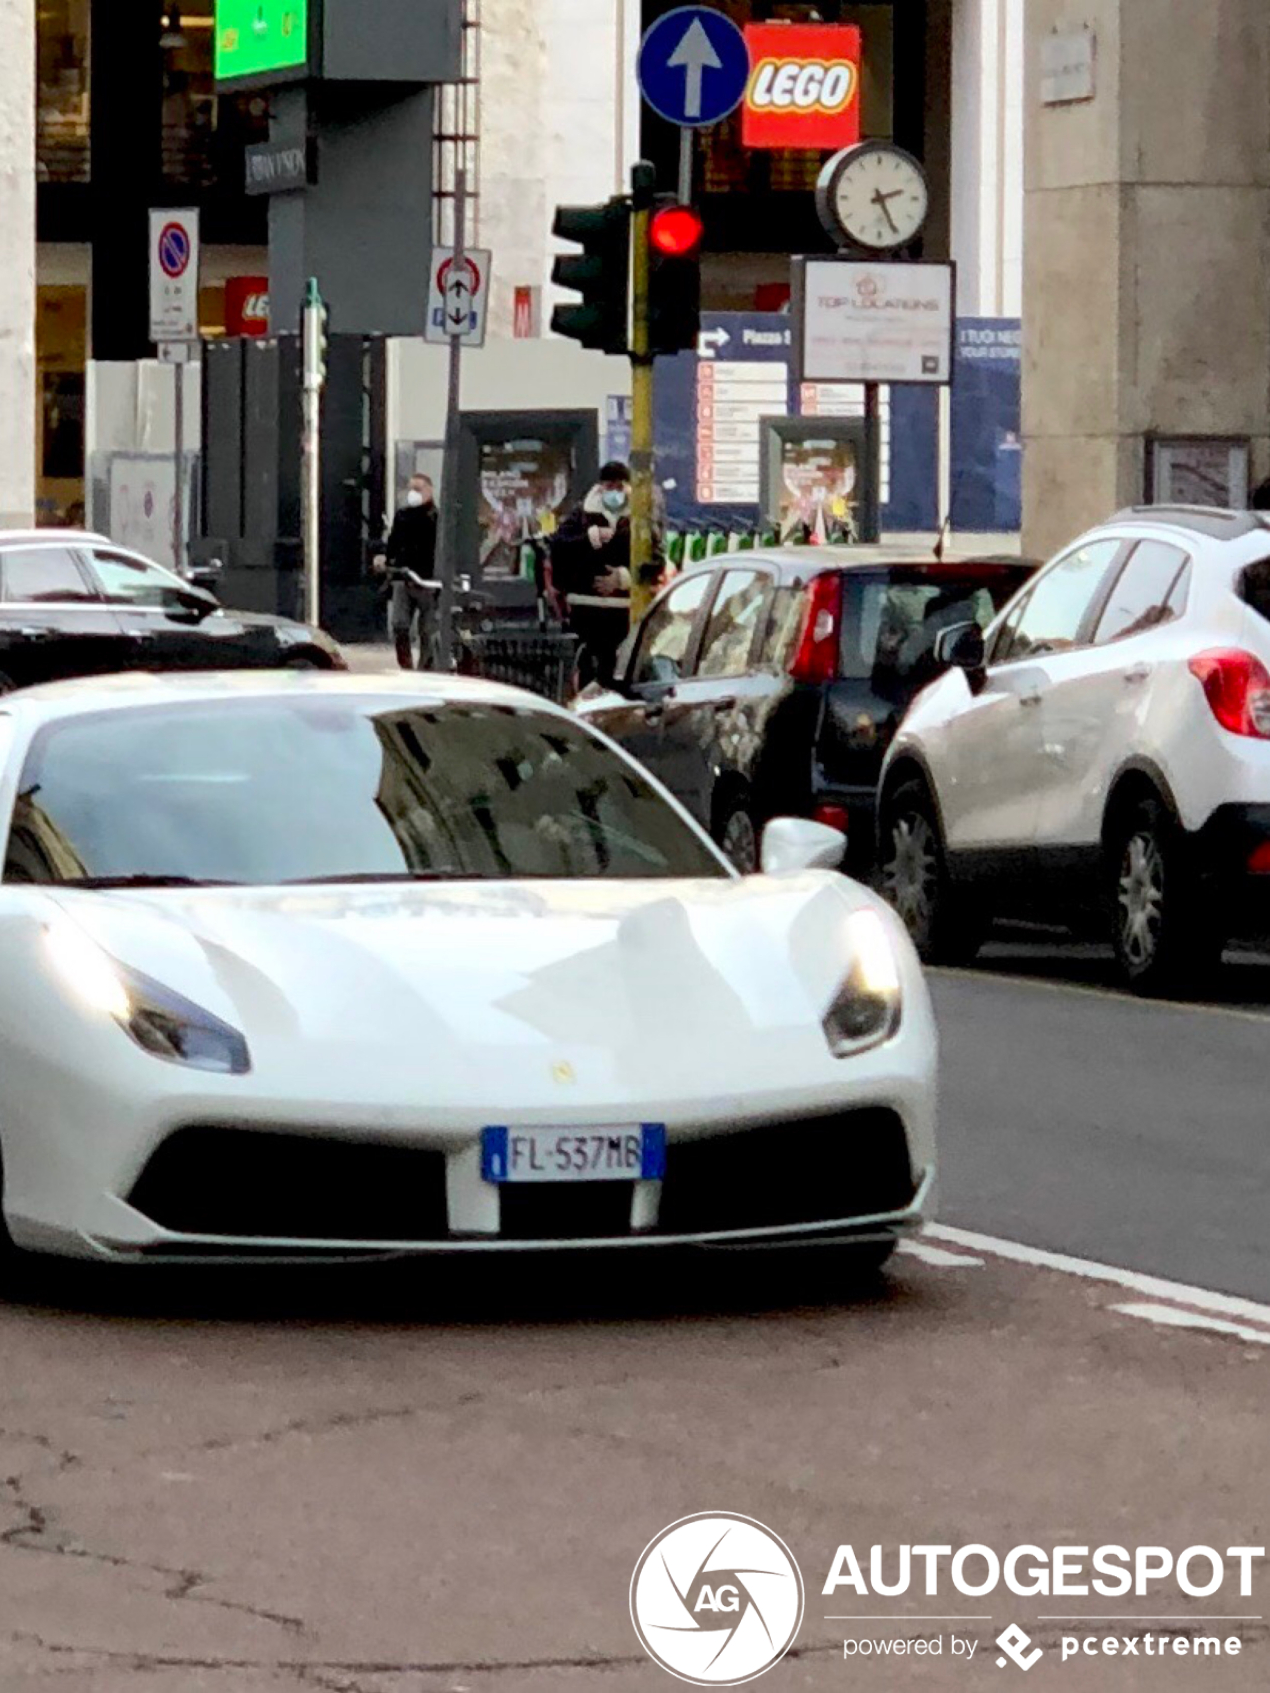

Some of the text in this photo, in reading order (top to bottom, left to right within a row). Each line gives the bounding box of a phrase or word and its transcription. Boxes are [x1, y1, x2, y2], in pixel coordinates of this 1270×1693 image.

[752, 63, 851, 107] LEGO
[817, 297, 939, 312] TOP LOCATIONS
